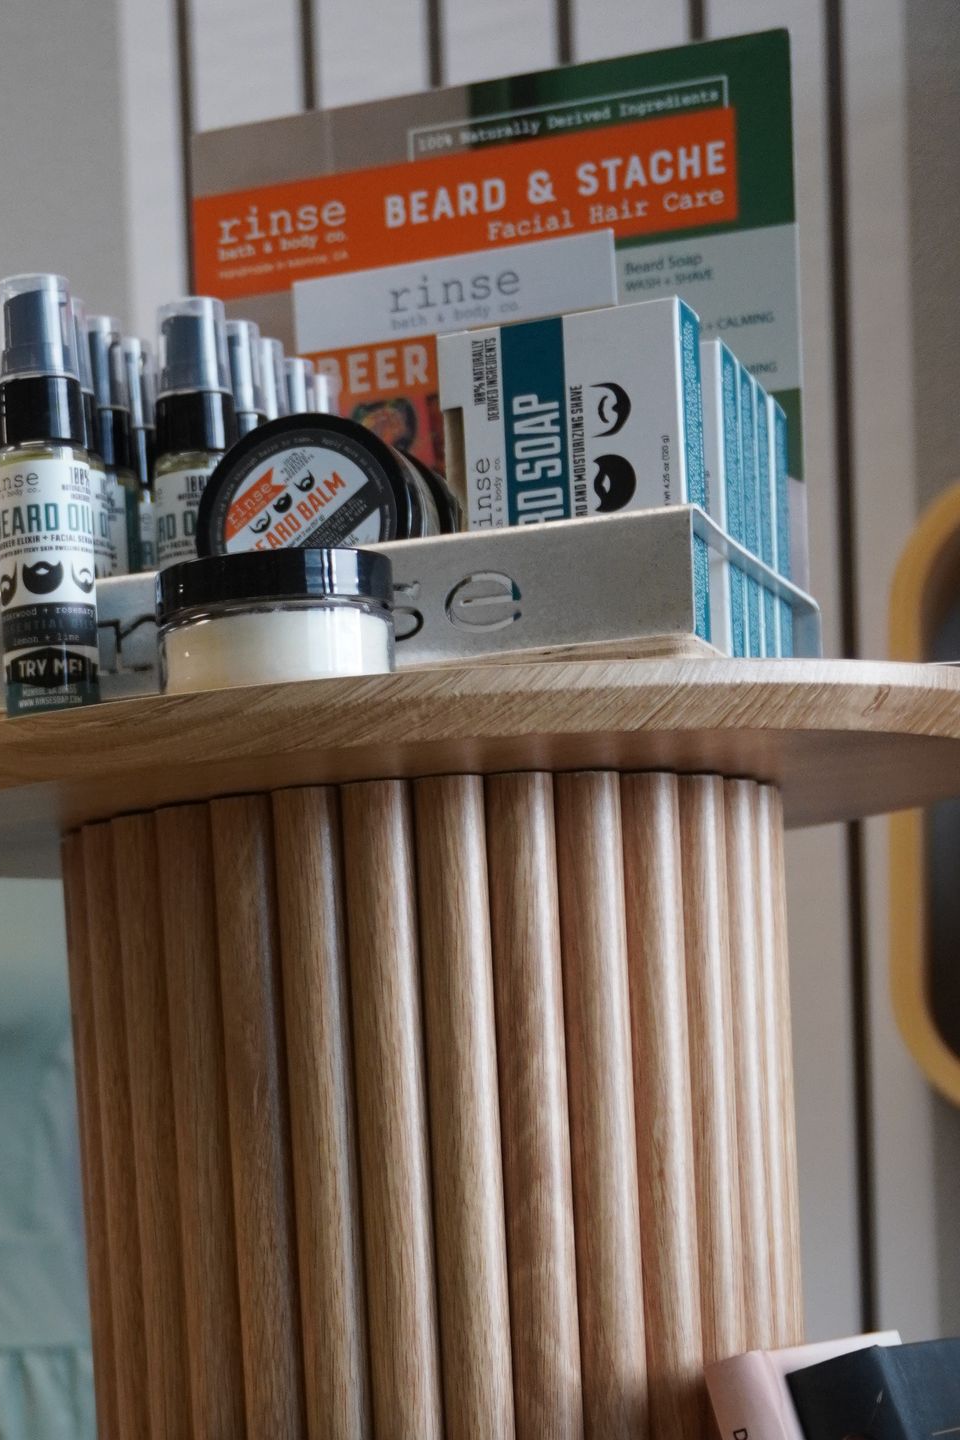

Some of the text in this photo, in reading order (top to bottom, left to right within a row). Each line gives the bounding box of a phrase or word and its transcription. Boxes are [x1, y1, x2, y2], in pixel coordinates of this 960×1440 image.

[460, 118, 540, 144] Naturally
[547, 104, 611, 128] Derived
[620, 90, 719, 117] Ingredients
[385, 141, 726, 229] BEARD & STACHE
[218, 201, 347, 245] rinse
[487, 188, 725, 240] Facial Hair Care
[280, 234, 318, 251] body
[625, 253, 703, 275] Beard Soap
[390, 269, 520, 313] rinse
[392, 303, 491, 331] bath body
[716, 311, 776, 331] CALMING
[471, 340, 487, 407] 100% NATURALLY
[484, 337, 500, 422] DERIVED INGREDIENTS
[511, 393, 563, 483] SOAP
[569, 384, 588, 504] AND MOISTURIZING SHAVE
[229, 482, 273, 525] rinse
[254, 512, 303, 551] EARD
[295, 470, 347, 522] BALM
[473, 457, 493, 528] inse
[494, 476, 505, 504] body
[55, 606, 96, 617] rosemary
[57, 632, 81, 642] lime
[17, 657, 83, 678] TRY ME!
